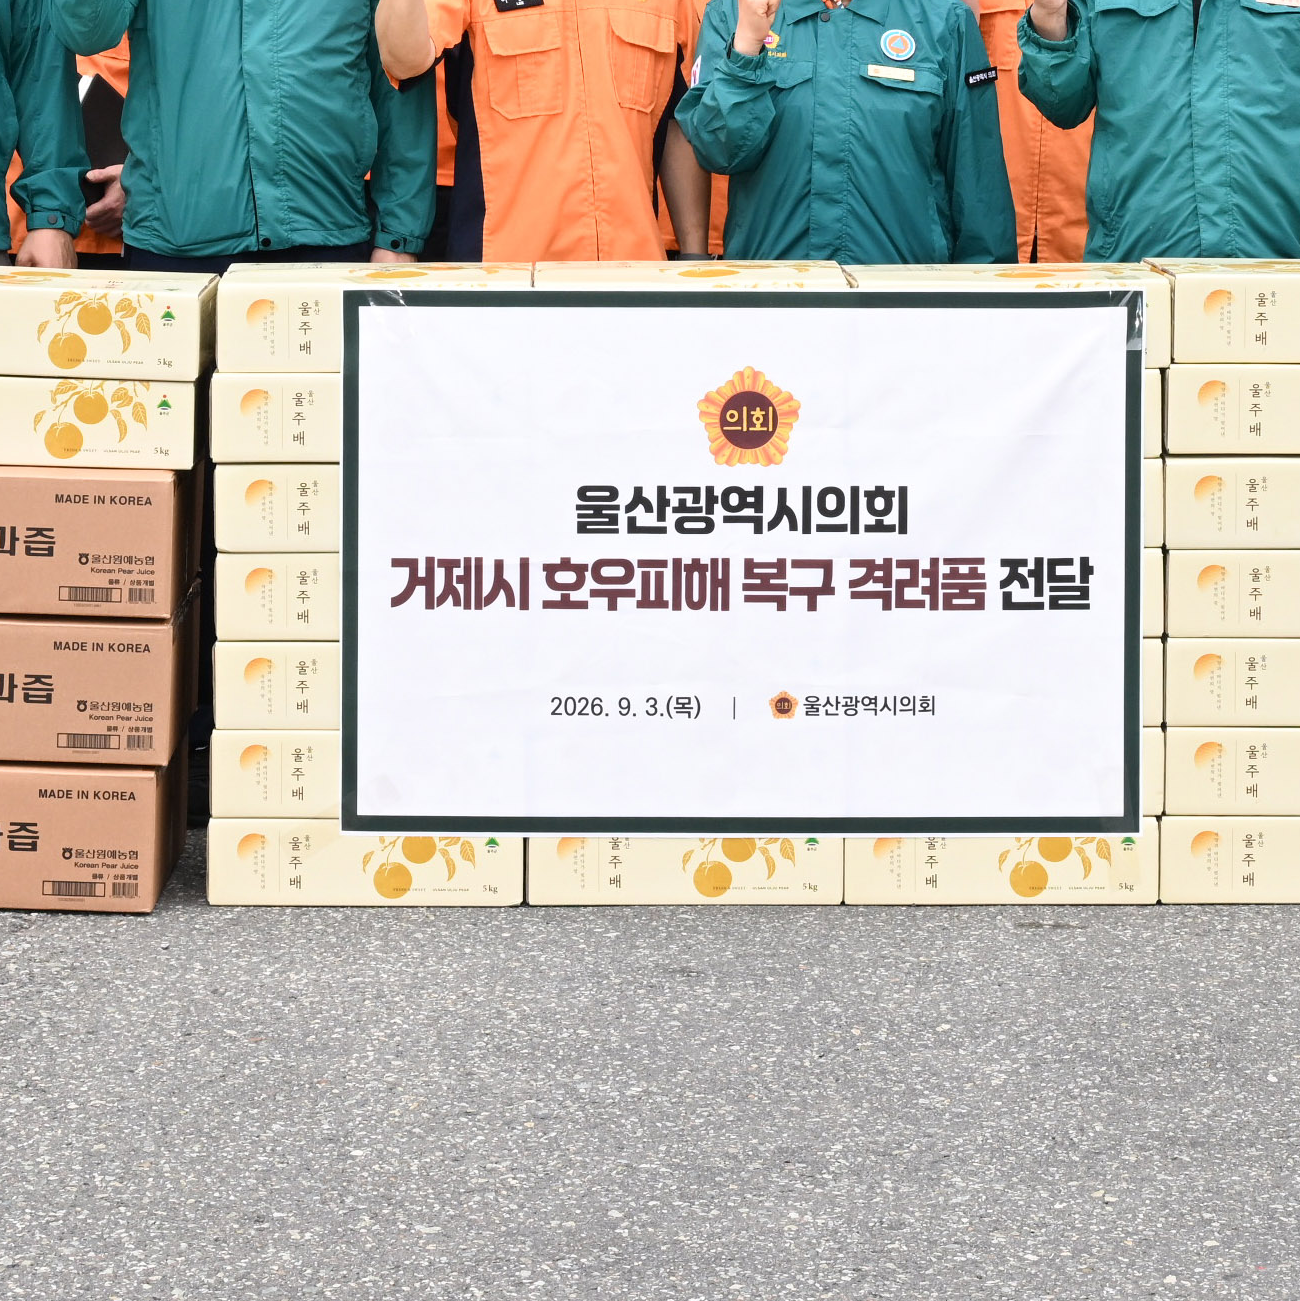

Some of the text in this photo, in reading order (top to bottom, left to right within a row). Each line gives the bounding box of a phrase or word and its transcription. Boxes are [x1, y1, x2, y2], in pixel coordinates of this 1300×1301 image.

[298, 301, 312, 355] 울주배
[1254, 292, 1268, 346] 울주배
[292, 392, 306, 446] 울주배
[723, 406, 775, 433] 의회
[1249, 383, 1263, 437] 울주배
[55, 493, 153, 506] MADE IN KOREA
[297, 482, 311, 535] 울주배
[574, 485, 909, 536] 울산광역시의회
[1245, 478, 1259, 531] 울주배
[90, 567, 155, 576] Korean Pear Juice
[91, 554, 155, 566] 울산원예농협
[390, 556, 1093, 612] 거제시 호우피해 복구 격려품 전달
[296, 571, 310, 624] 울주배
[1248, 568, 1262, 621] 울주배
[53, 641, 151, 654] MADE IN KOREA
[89, 700, 154, 713] 울산원예농협
[296, 661, 310, 714] 울주배
[549, 692, 702, 722] 2026. 9. 3.(목)
[802, 694, 937, 718] 울산광역시의회
[1245, 656, 1259, 709] 울주배
[134, 714, 154, 722] Juice
[38, 789, 136, 801] MADE IN KOREA
[291, 748, 305, 801] 울주배
[1245, 745, 1259, 797] 울주배
[74, 848, 139, 860] 울산원예농협
[120, 862, 139, 870] Juice
[289, 836, 303, 890] 울주배
[1242, 834, 1256, 886] 울주배
